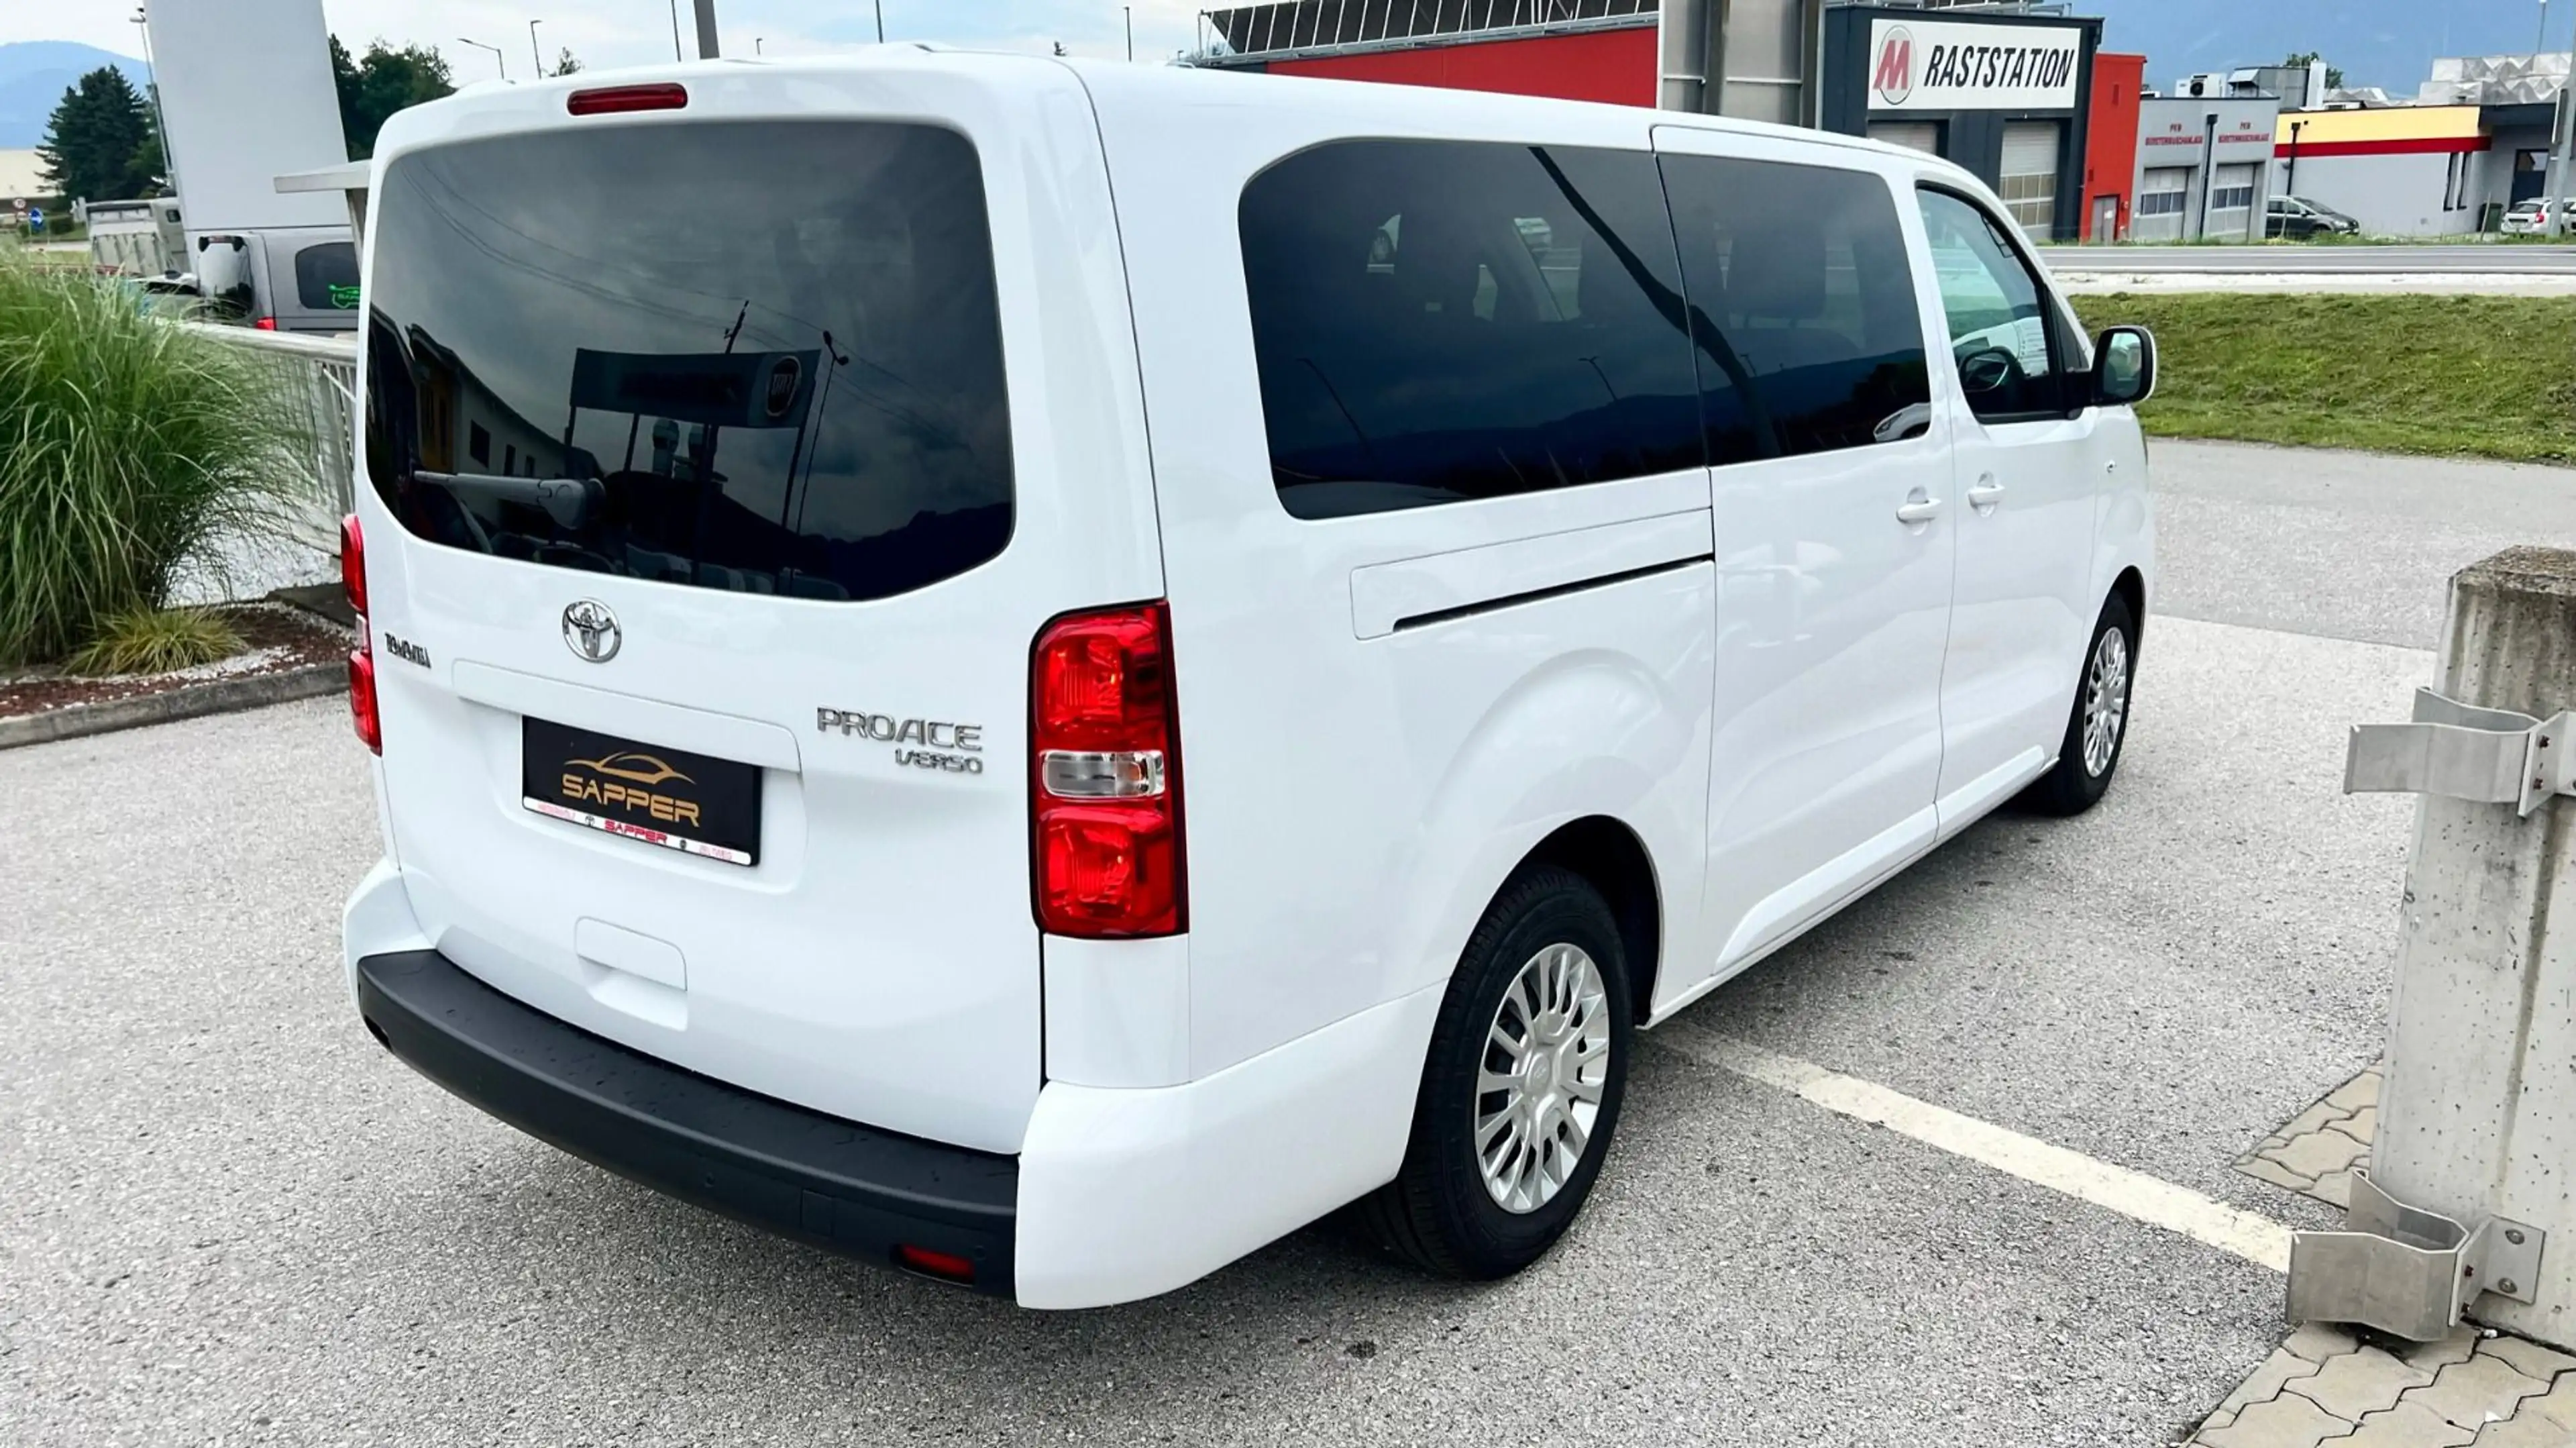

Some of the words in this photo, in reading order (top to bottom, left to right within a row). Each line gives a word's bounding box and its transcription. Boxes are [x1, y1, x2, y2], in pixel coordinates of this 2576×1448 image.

[1924, 45, 2075, 87] RASTSTATION
[817, 707, 983, 752] PROACE
[895, 747, 983, 774] VERSO
[561, 774, 700, 827] SAPPER
[605, 819, 667, 844] SAPPER
